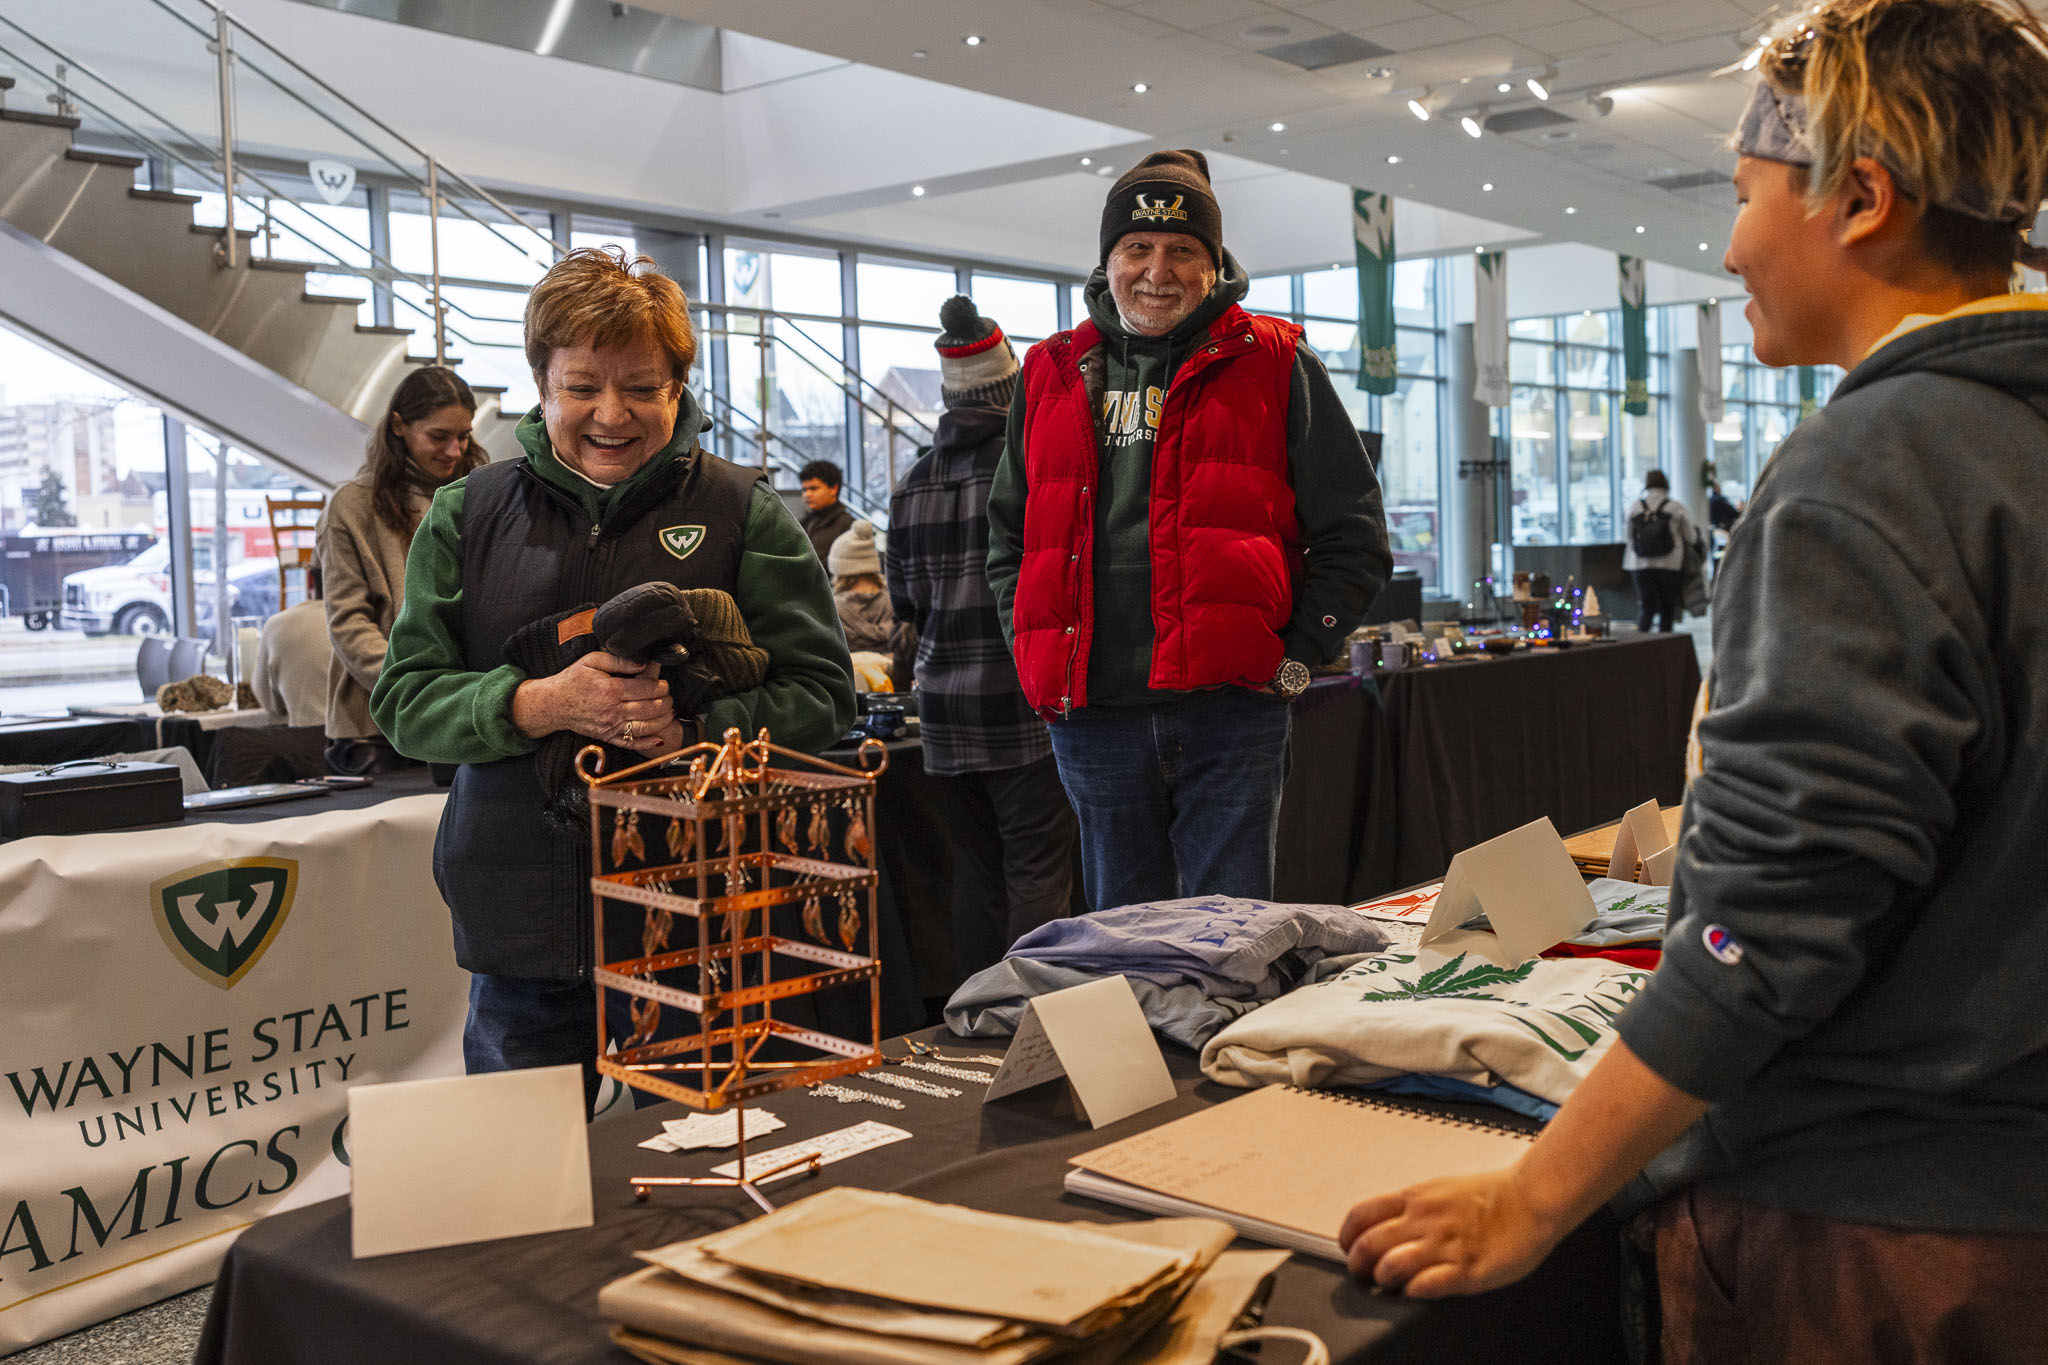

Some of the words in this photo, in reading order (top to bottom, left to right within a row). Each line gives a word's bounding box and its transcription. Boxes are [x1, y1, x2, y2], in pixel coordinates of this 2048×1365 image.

[1135, 208, 1161, 218] WAYNE
[1162, 208, 1184, 219] STATE
[4, 1028, 232, 1118] WAYNE
[251, 988, 411, 1063] STATE
[78, 1053, 356, 1148] UNIVERSITY
[0, 1125, 300, 1281] AMICS
